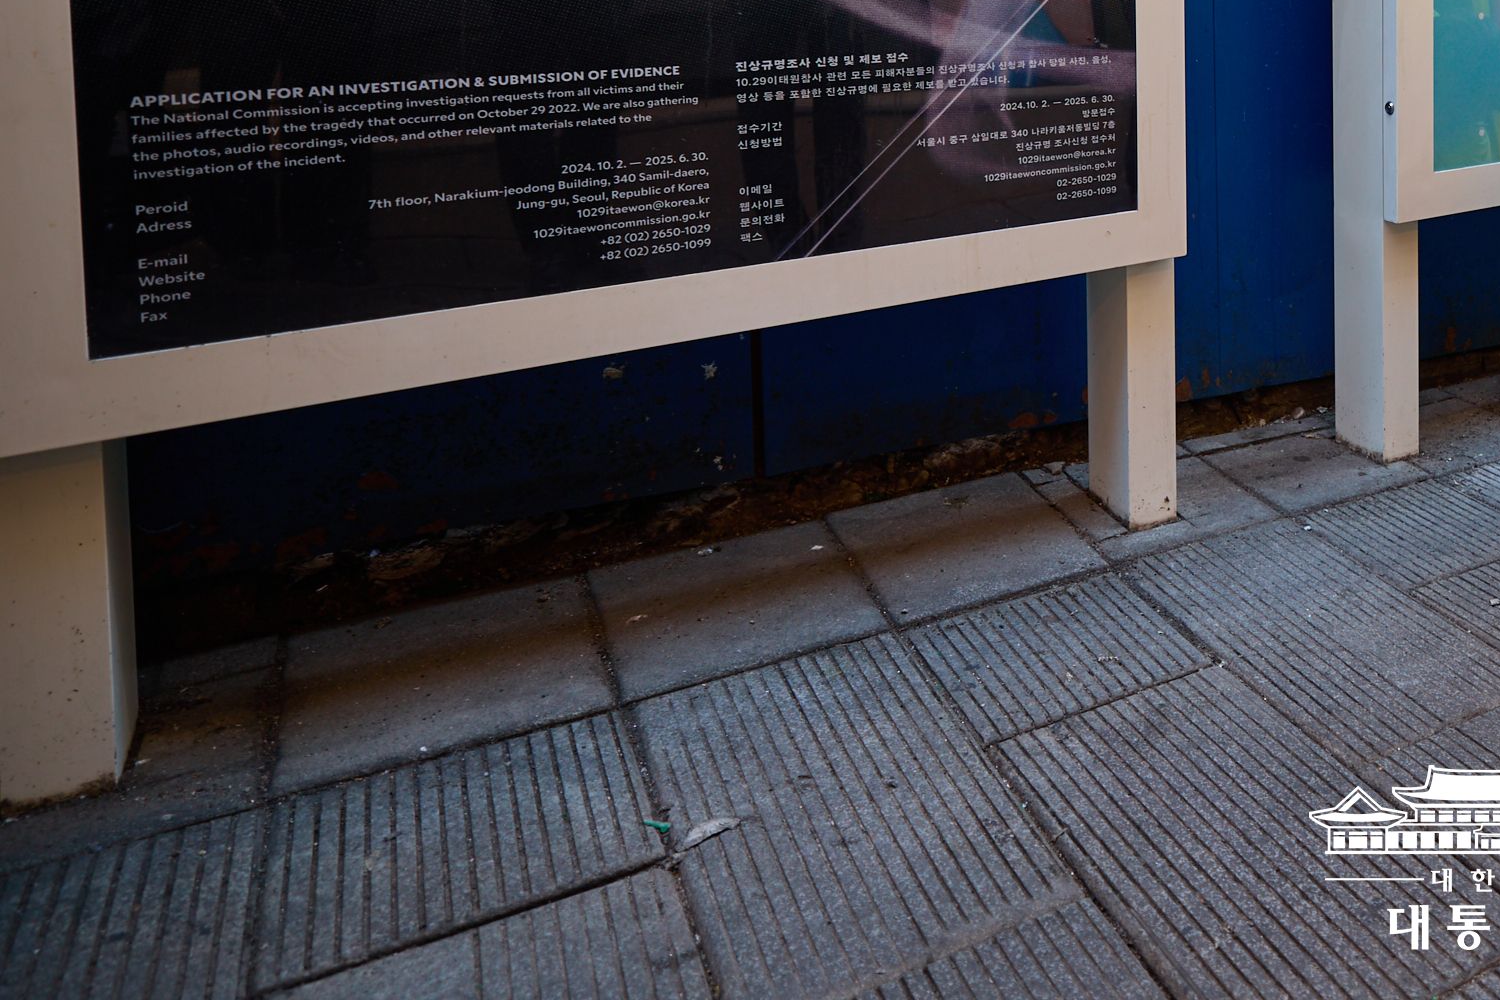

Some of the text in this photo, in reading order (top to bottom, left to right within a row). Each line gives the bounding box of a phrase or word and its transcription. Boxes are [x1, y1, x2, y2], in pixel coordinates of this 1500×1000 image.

[130, 65, 680, 108] APPLICATION FOR AN INVESTIGATION & SUBMISSION OF EVIDENCE
[131, 81, 685, 125] The National Commission is accepting investigation requests from all victims and their
[1000, 101, 1038, 111] 2024.10.
[1041, 100, 1050, 108] 2.
[1064, 97, 1089, 106] 2025.
[1102, 94, 1115, 103] 30.
[132, 131, 192, 144] families
[196, 125, 258, 139] affected
[262, 125, 280, 136] by
[283, 123, 307, 133] the
[310, 118, 364, 132] tragedy
[367, 116, 396, 127] that
[398, 112, 455, 124] occurred
[477, 108, 529, 119] October
[531, 105, 546, 115] 29
[548, 103, 580, 114] 2022.
[582, 102, 601, 111] We
[602, 102, 621, 110] are
[623, 99, 645, 109] also
[647, 95, 699, 108] gathering
[133, 113, 652, 162] the photos, audio recordings, videos, and other relevant materials related to the
[1011, 129, 1029, 138] 340
[134, 154, 346, 180] investigation of the incident.
[561, 163, 595, 174] 2024.
[597, 161, 614, 170] 10.
[616, 160, 627, 169] 2.
[645, 155, 677, 166] 2025.
[679, 154, 689, 163] 6.
[691, 152, 709, 162] 30.
[368, 198, 392, 209] 7th
[395, 197, 431, 207] floor,
[558, 177, 611, 190] Building,
[613, 173, 636, 184] 340
[639, 168, 709, 182] Samil-daero,
[1056, 173, 1117, 187] 02-2650-1029
[516, 182, 710, 210] Jung-gu, Seoul, Republic of Korea
[1056, 186, 1117, 200] 02-2650-1099
[135, 201, 188, 216] Peroid
[136, 221, 192, 234] Adress
[600, 224, 711, 245] +82 (02) 2650-1029
[600, 238, 711, 260] +82 (02) 2650-1099
[138, 254, 188, 269] E-mail
[138, 271, 205, 287] Website
[140, 291, 191, 305] Phone
[140, 312, 167, 323] Fax
